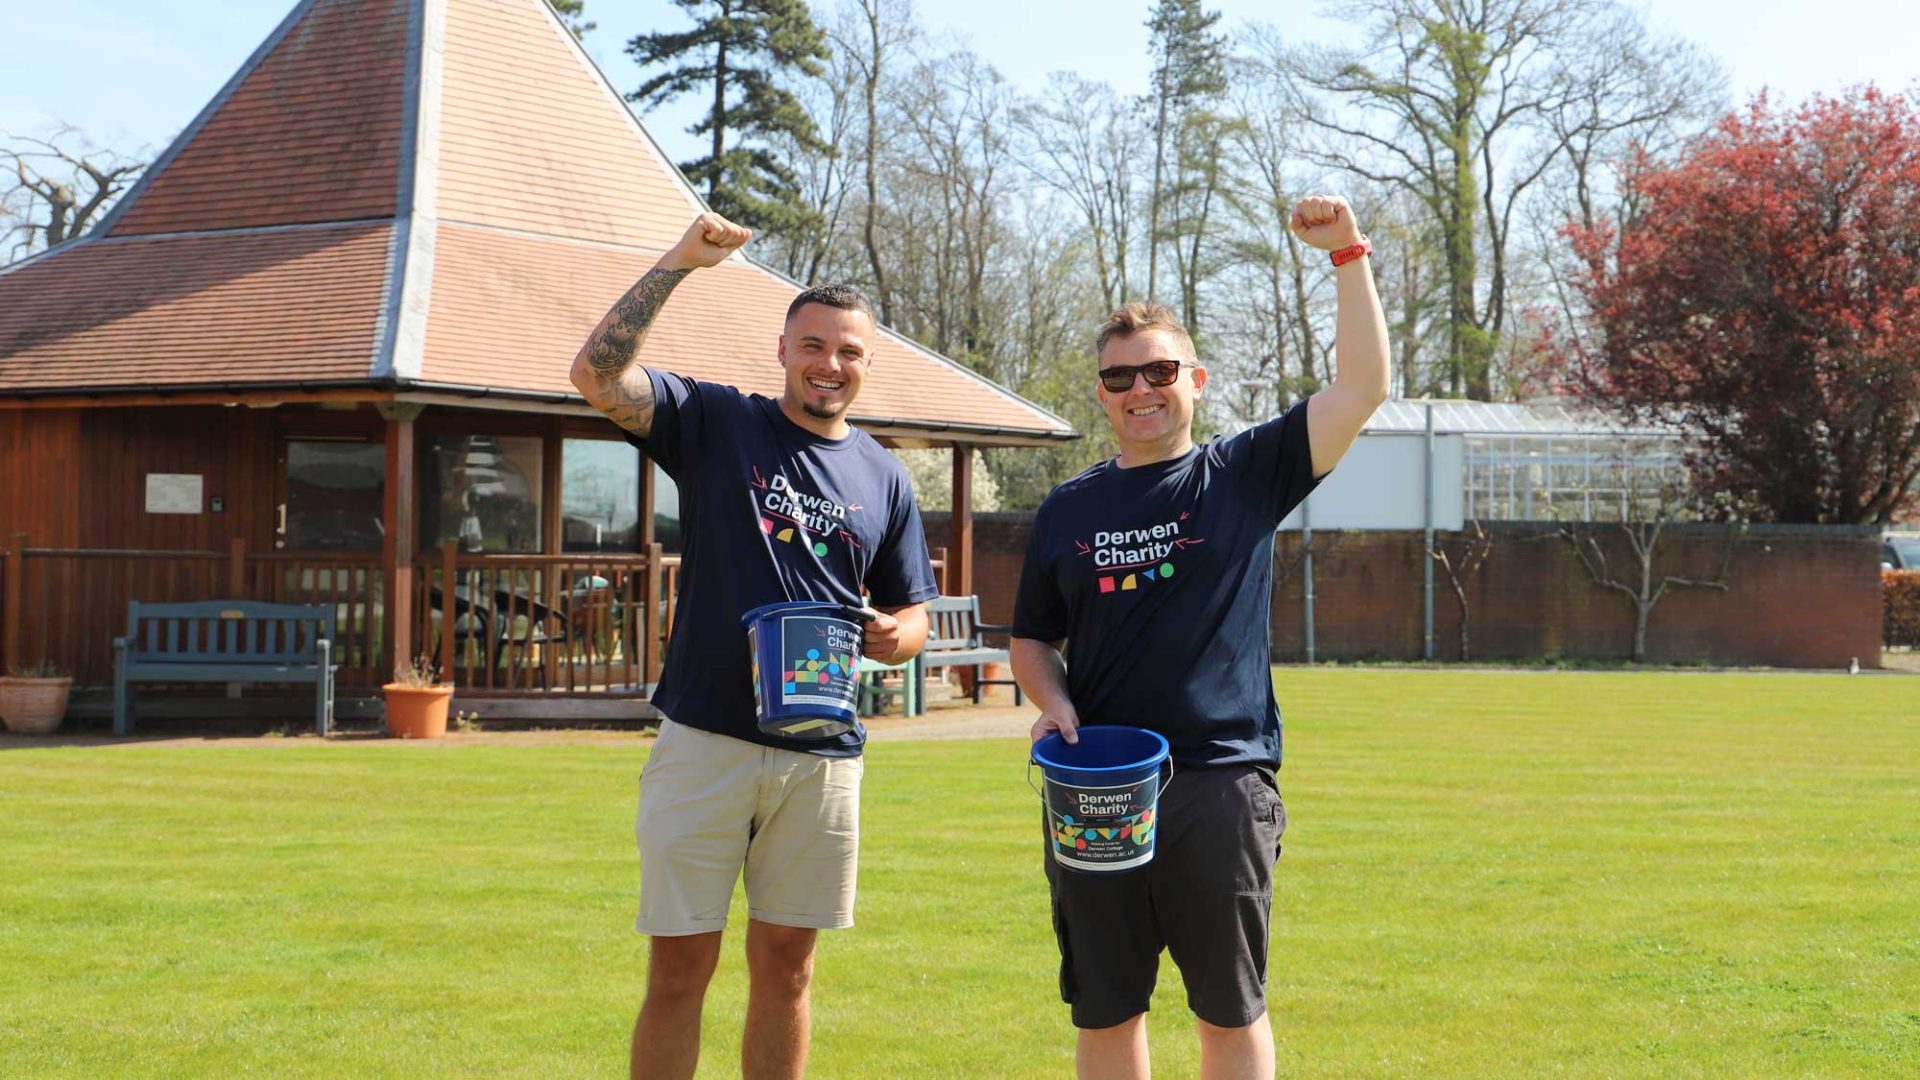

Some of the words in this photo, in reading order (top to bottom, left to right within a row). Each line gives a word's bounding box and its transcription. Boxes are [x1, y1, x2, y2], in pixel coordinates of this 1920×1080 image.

[770, 474, 846, 519] Derwen
[765, 493, 837, 537] Charity
[1095, 521, 1179, 547] Derwen
[1094, 541, 1174, 566] Charity
[1078, 792, 1131, 804] Derwen
[1079, 804, 1128, 815] Charity
[1076, 849, 1135, 858] www.derwen.ac.uk
